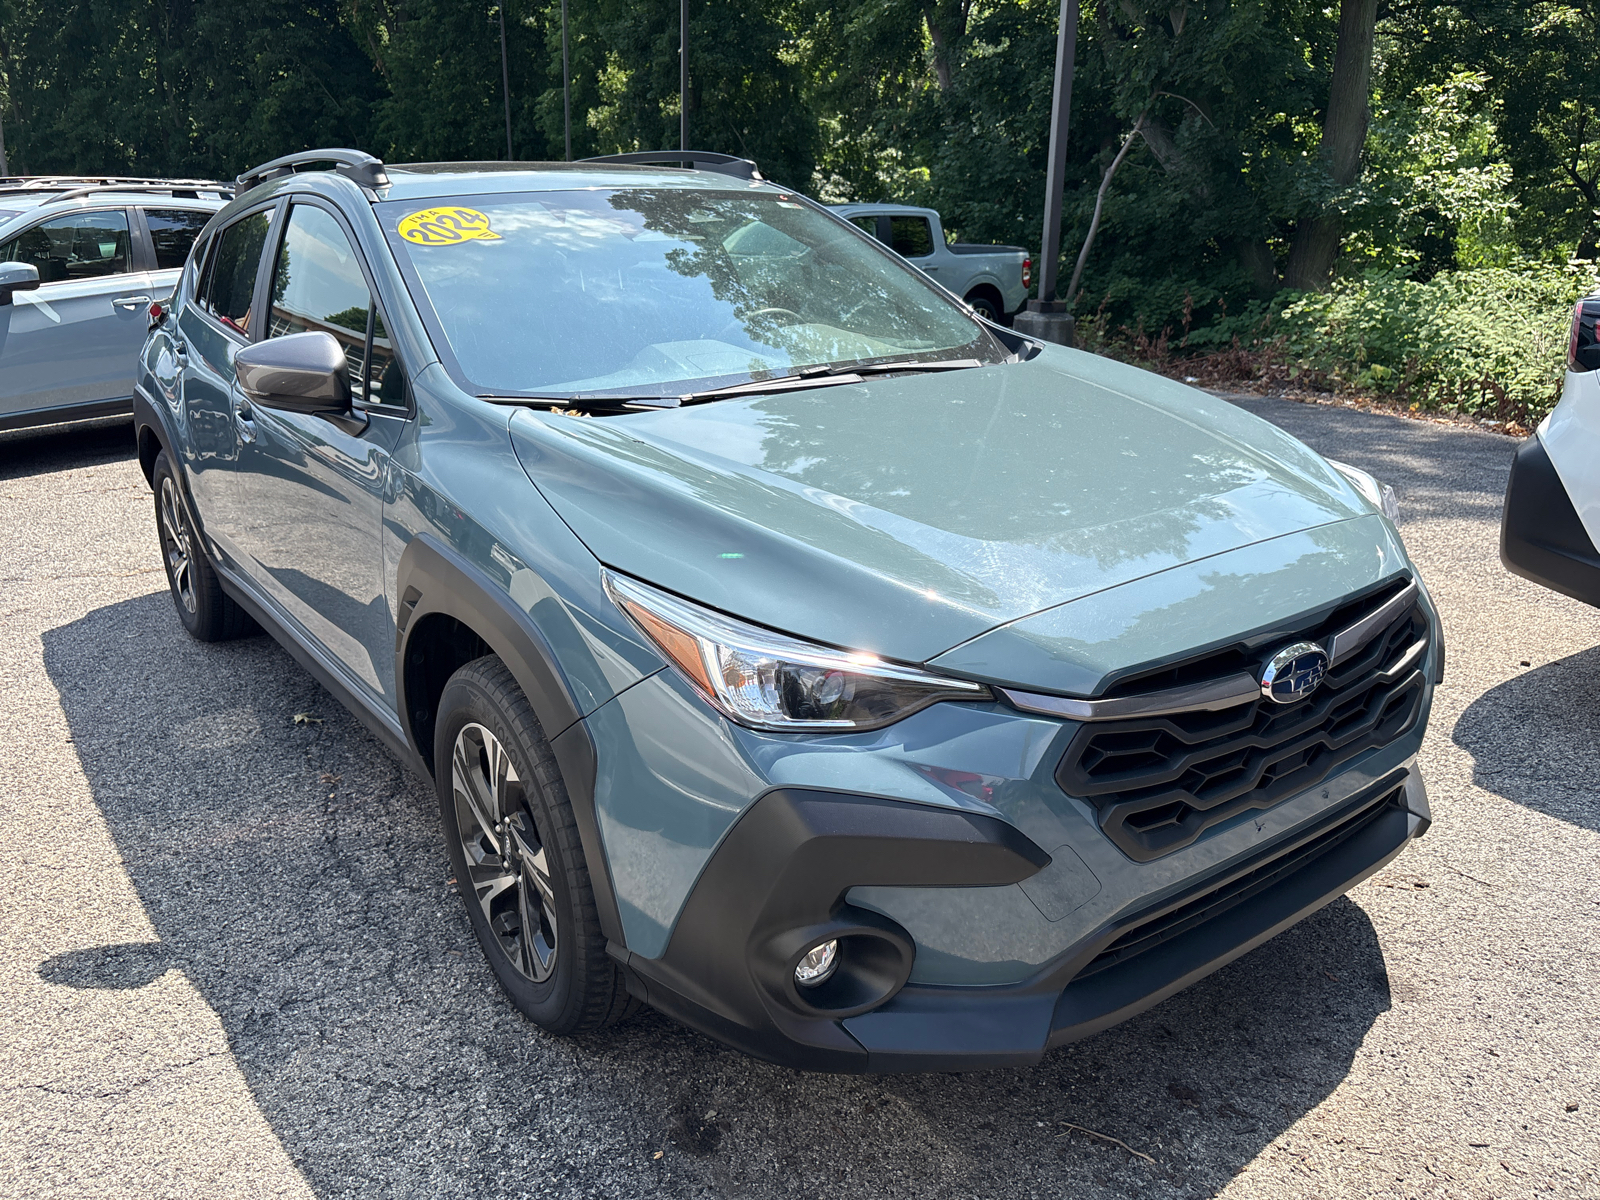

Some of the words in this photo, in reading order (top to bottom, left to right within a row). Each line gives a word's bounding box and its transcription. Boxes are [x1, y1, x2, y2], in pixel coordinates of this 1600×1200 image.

[406, 209, 487, 243] 2024
[408, 213, 429, 223] I'M
[492, 715, 545, 828] YOKOHAMA
